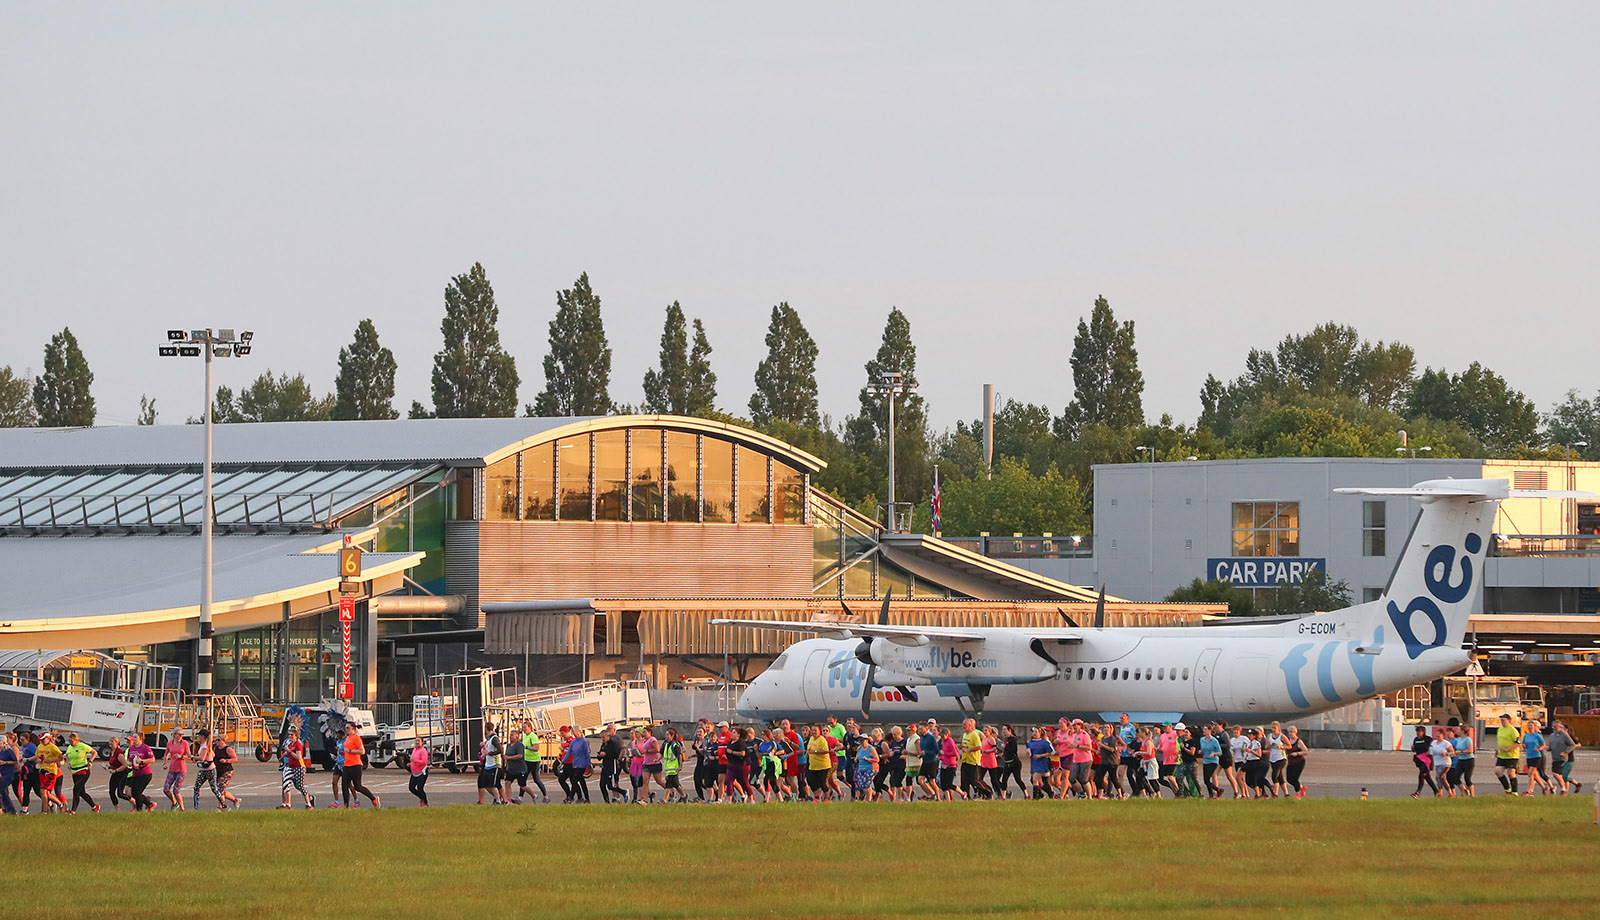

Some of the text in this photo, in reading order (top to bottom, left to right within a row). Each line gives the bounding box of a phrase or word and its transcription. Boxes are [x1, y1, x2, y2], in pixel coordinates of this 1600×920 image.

[345, 553, 357, 574] 6
[1216, 561, 1318, 583] CAR PARK
[1298, 623, 1336, 634] G-ECOM
[904, 646, 997, 673] www.flybe.com
[1279, 625, 1384, 709] fly
